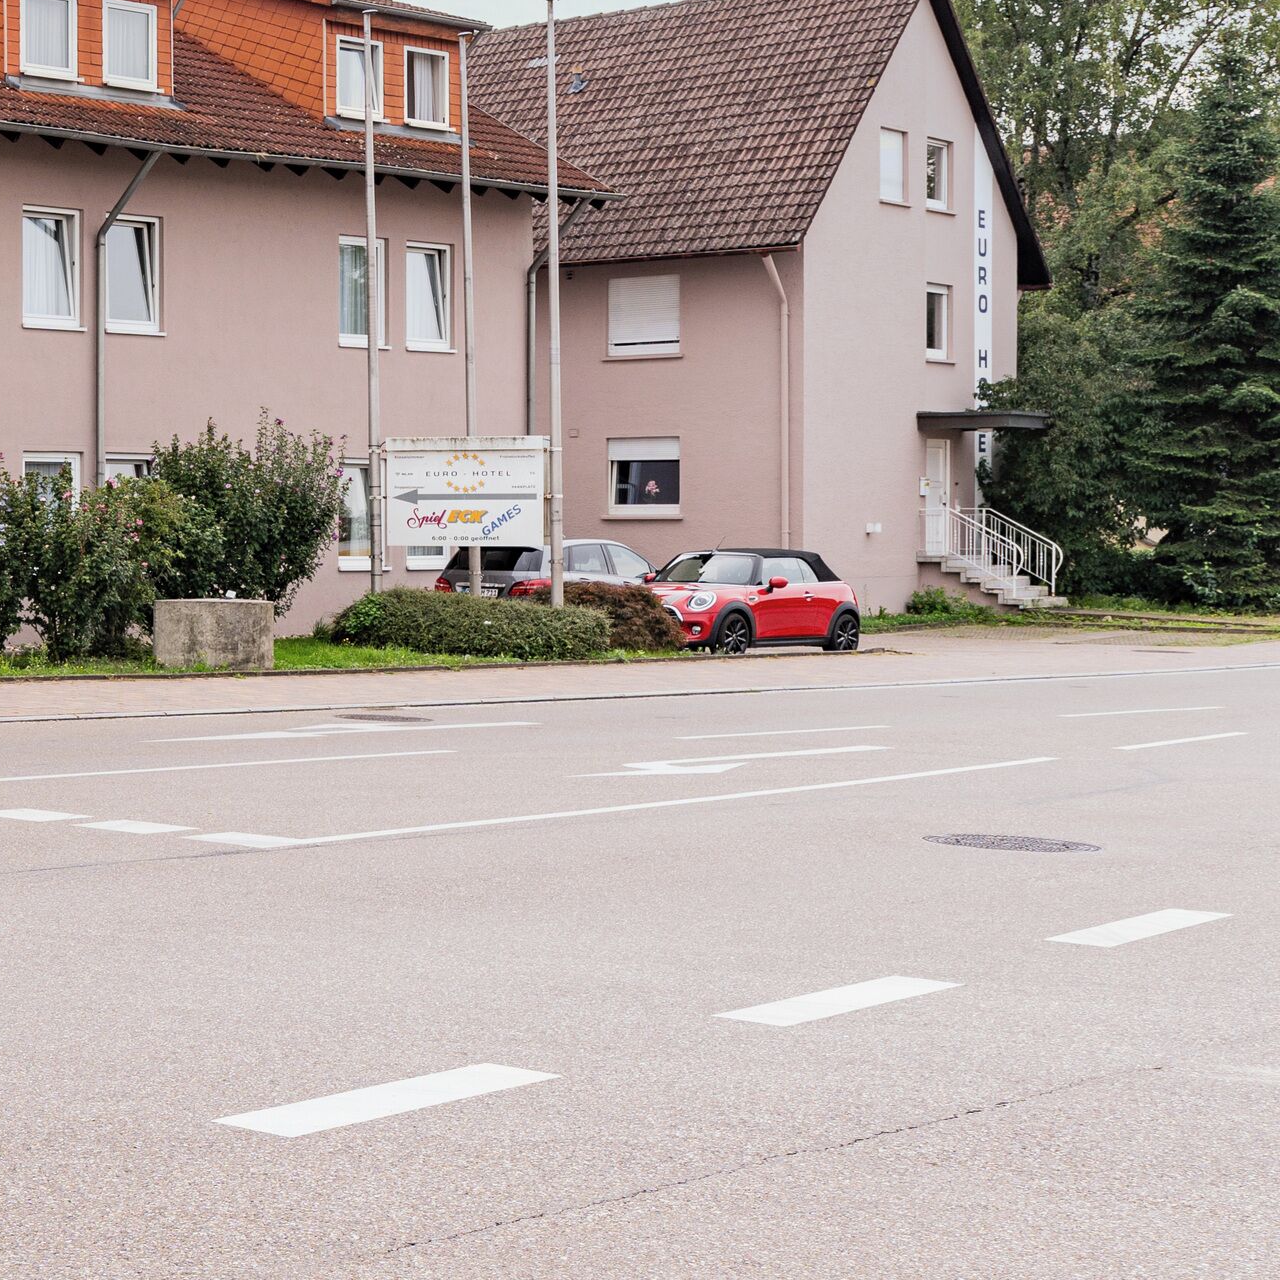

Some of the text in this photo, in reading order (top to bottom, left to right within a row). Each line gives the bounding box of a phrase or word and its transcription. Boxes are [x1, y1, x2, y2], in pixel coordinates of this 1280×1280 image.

[978, 210, 988, 313] EURO
[406, 507, 488, 529] Spiel ECK
[481, 504, 522, 536] GAMES
